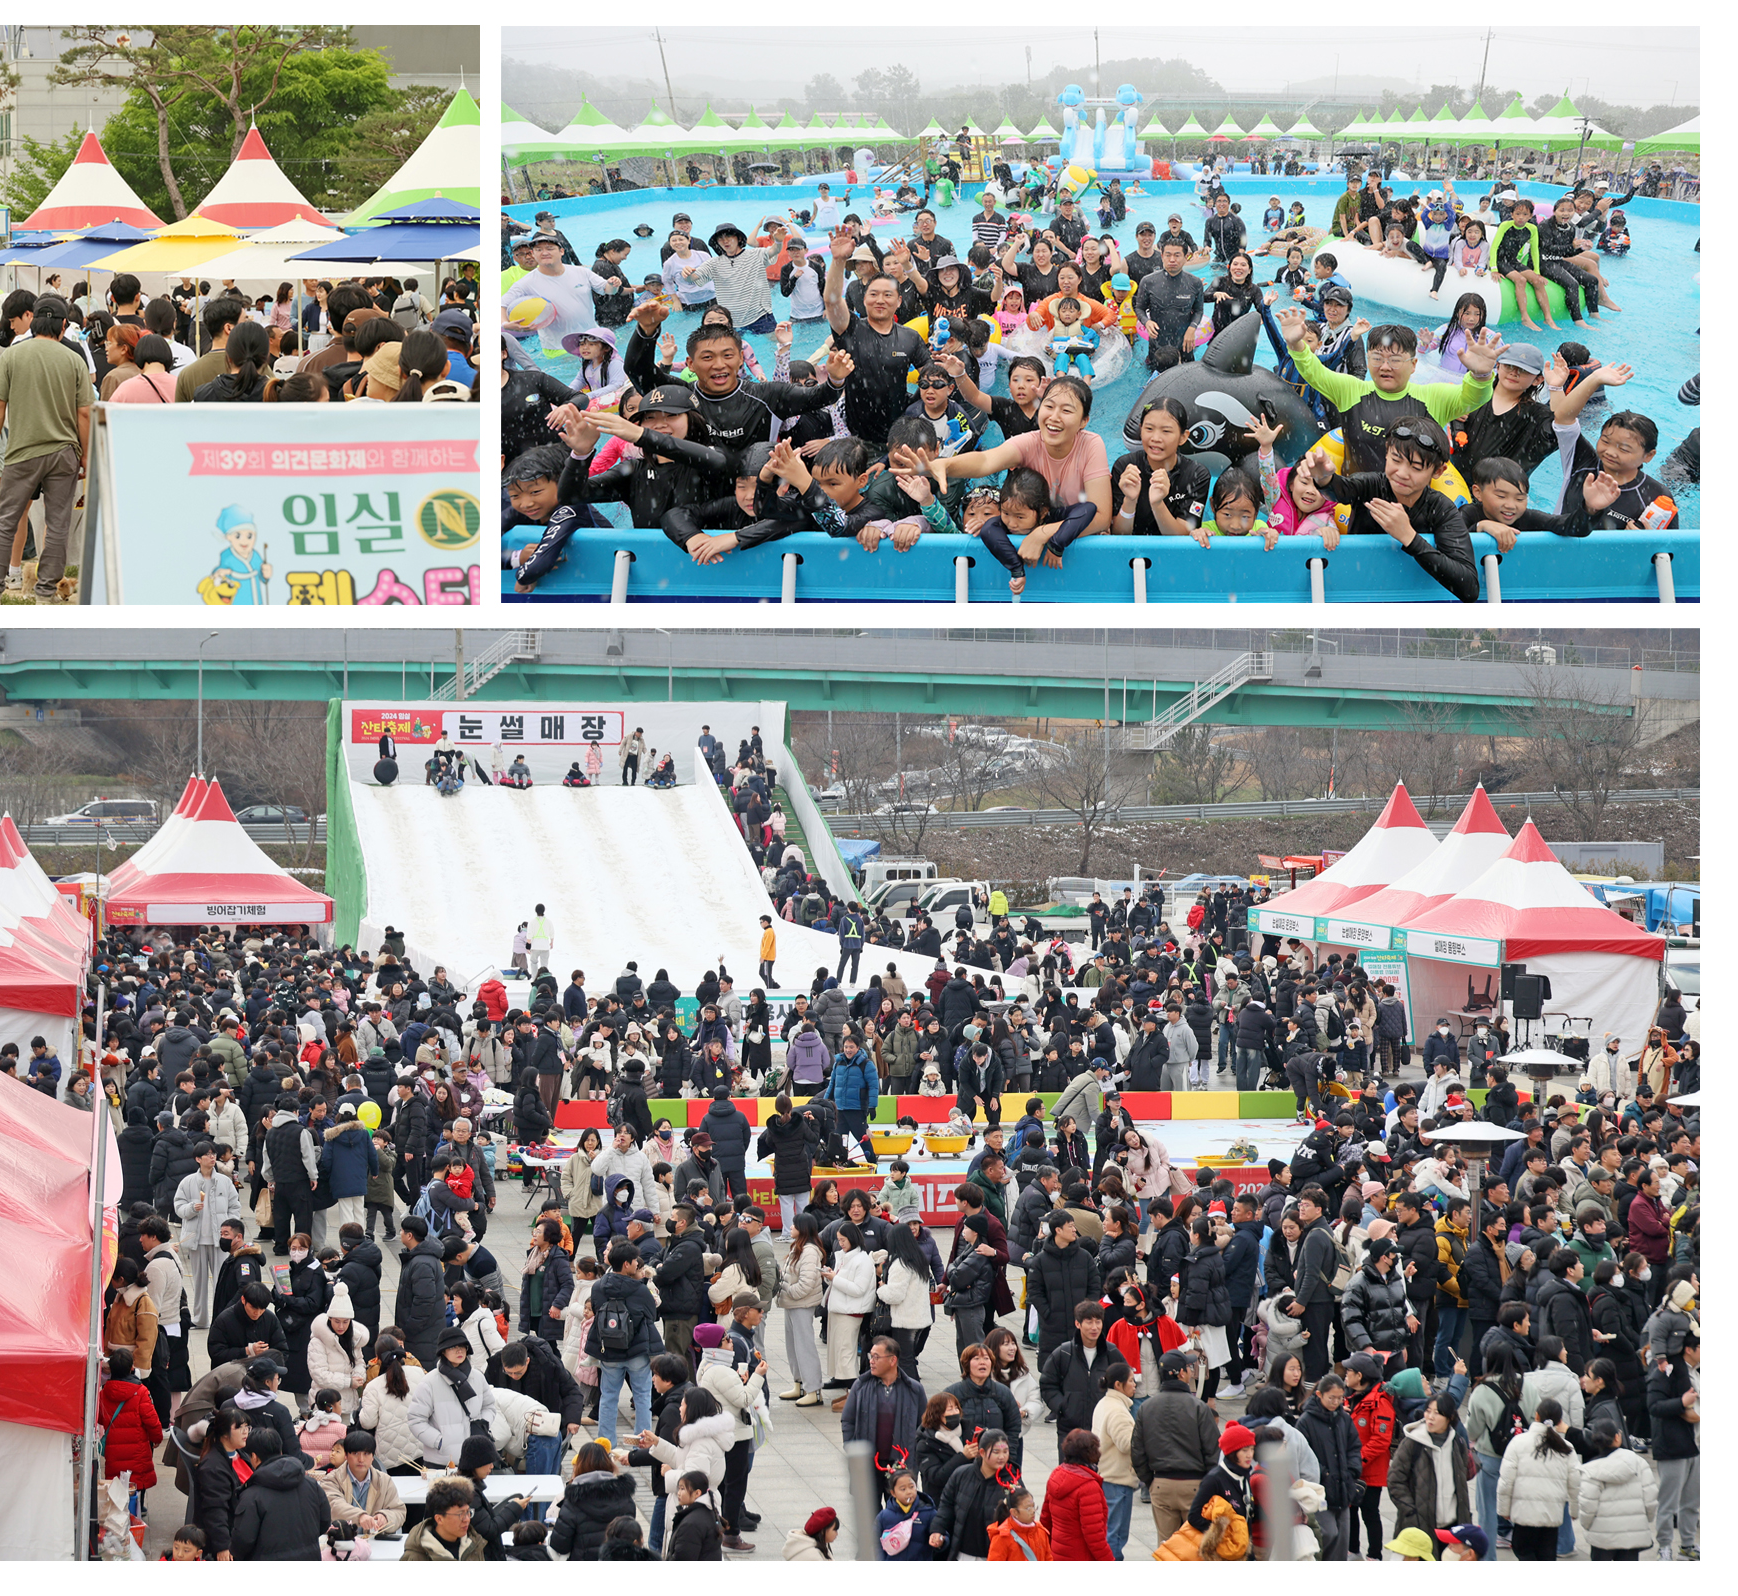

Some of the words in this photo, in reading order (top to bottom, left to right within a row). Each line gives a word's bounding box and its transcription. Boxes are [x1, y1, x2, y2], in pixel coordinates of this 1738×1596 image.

[649, 388, 665, 404] LA
[201, 449, 265, 469] 제39회
[271, 448, 386, 470] 의견문화제와
[390, 447, 466, 468] 함께하는
[282, 491, 405, 555] 임실
[361, 720, 411, 735] 산타축제
[459, 715, 606, 740] 눈썰매장
[206, 905, 266, 916] 빙어잡기체험
